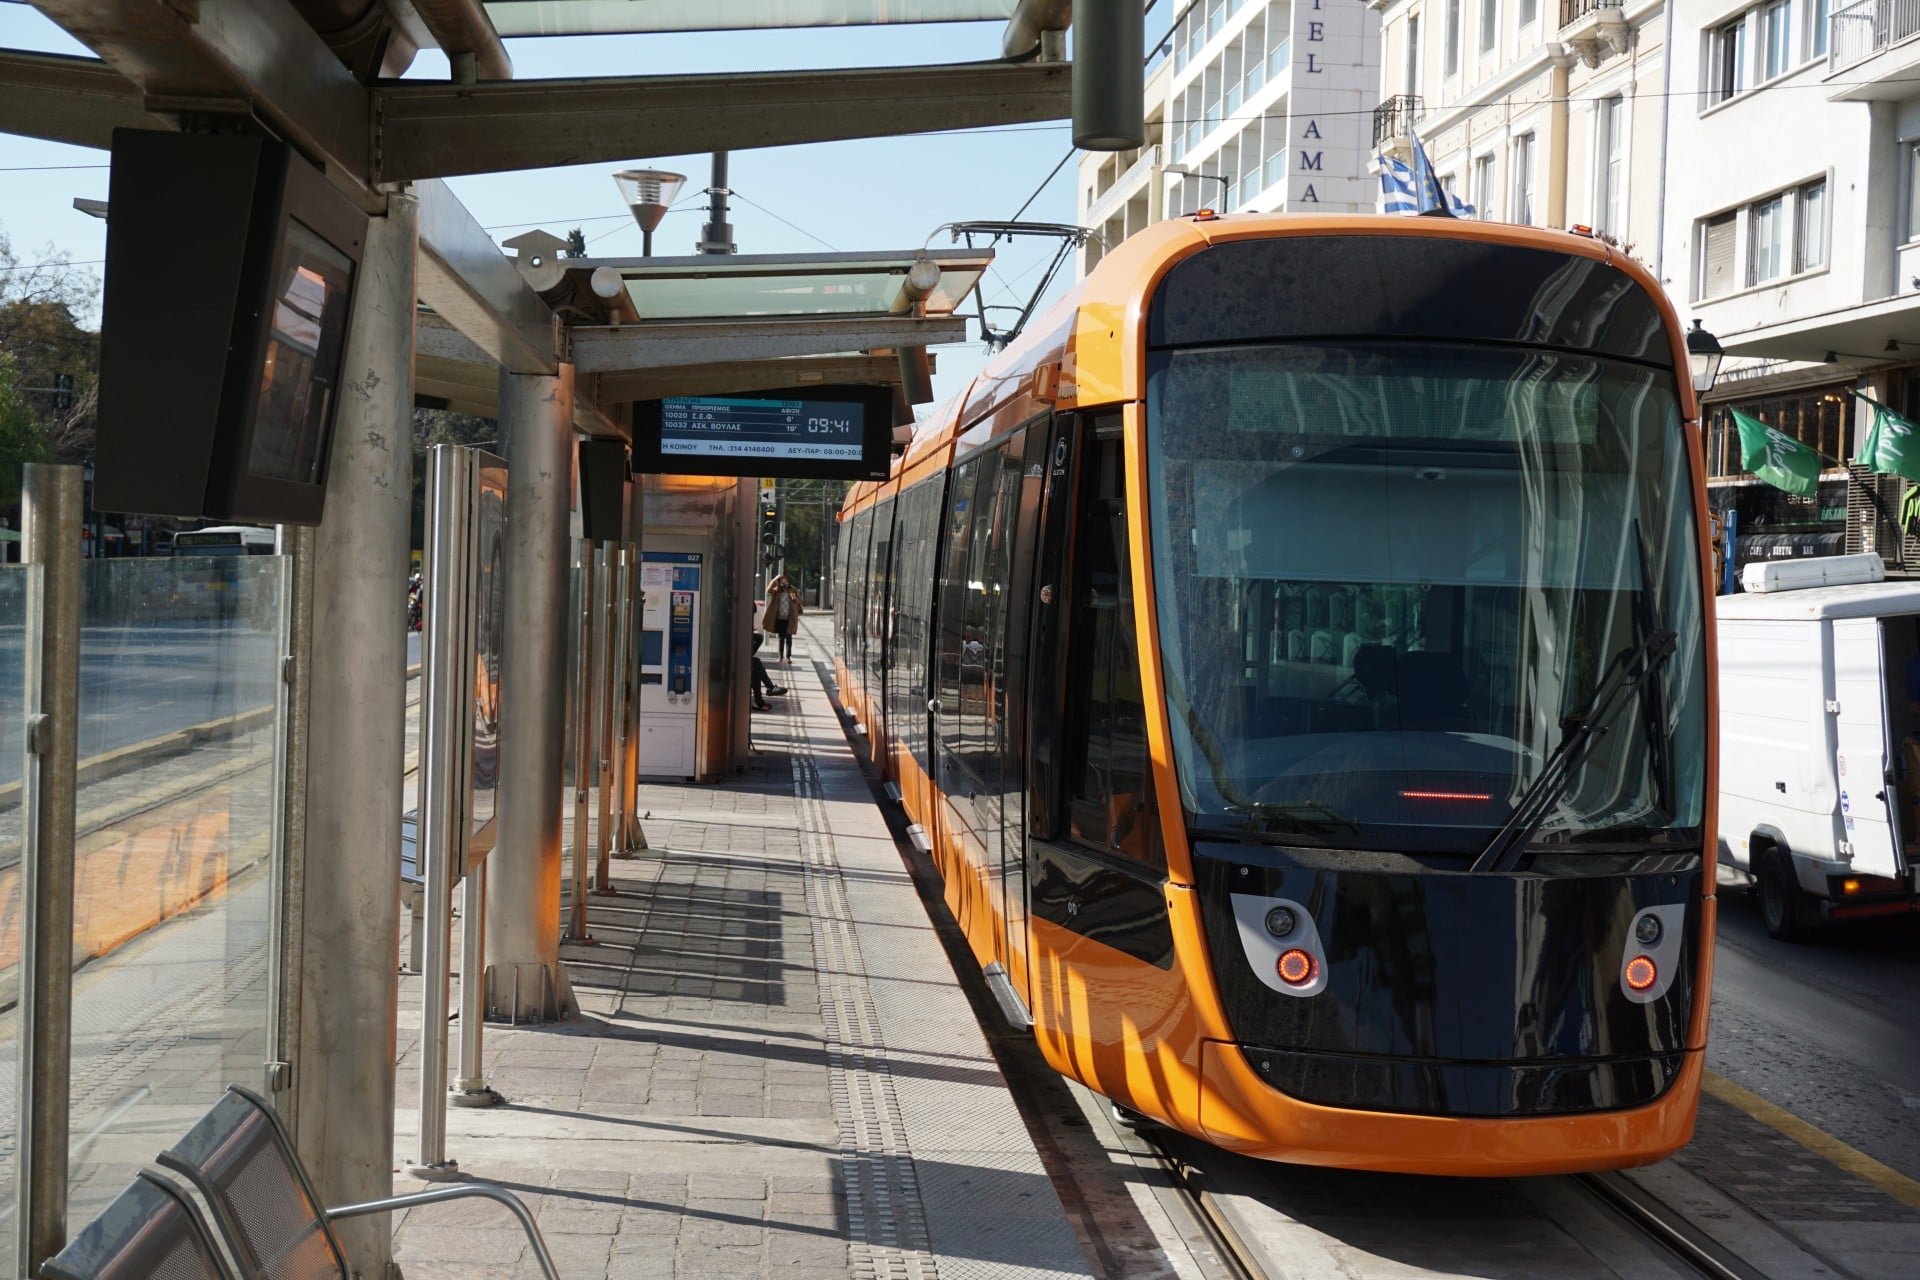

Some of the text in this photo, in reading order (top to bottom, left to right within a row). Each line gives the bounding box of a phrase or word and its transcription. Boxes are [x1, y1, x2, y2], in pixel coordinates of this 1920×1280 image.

[1299, 119, 1324, 203] AMA
[711, 423, 742, 431] ΒΟΥΛΑΣ
[808, 417, 849, 433] 09:41
